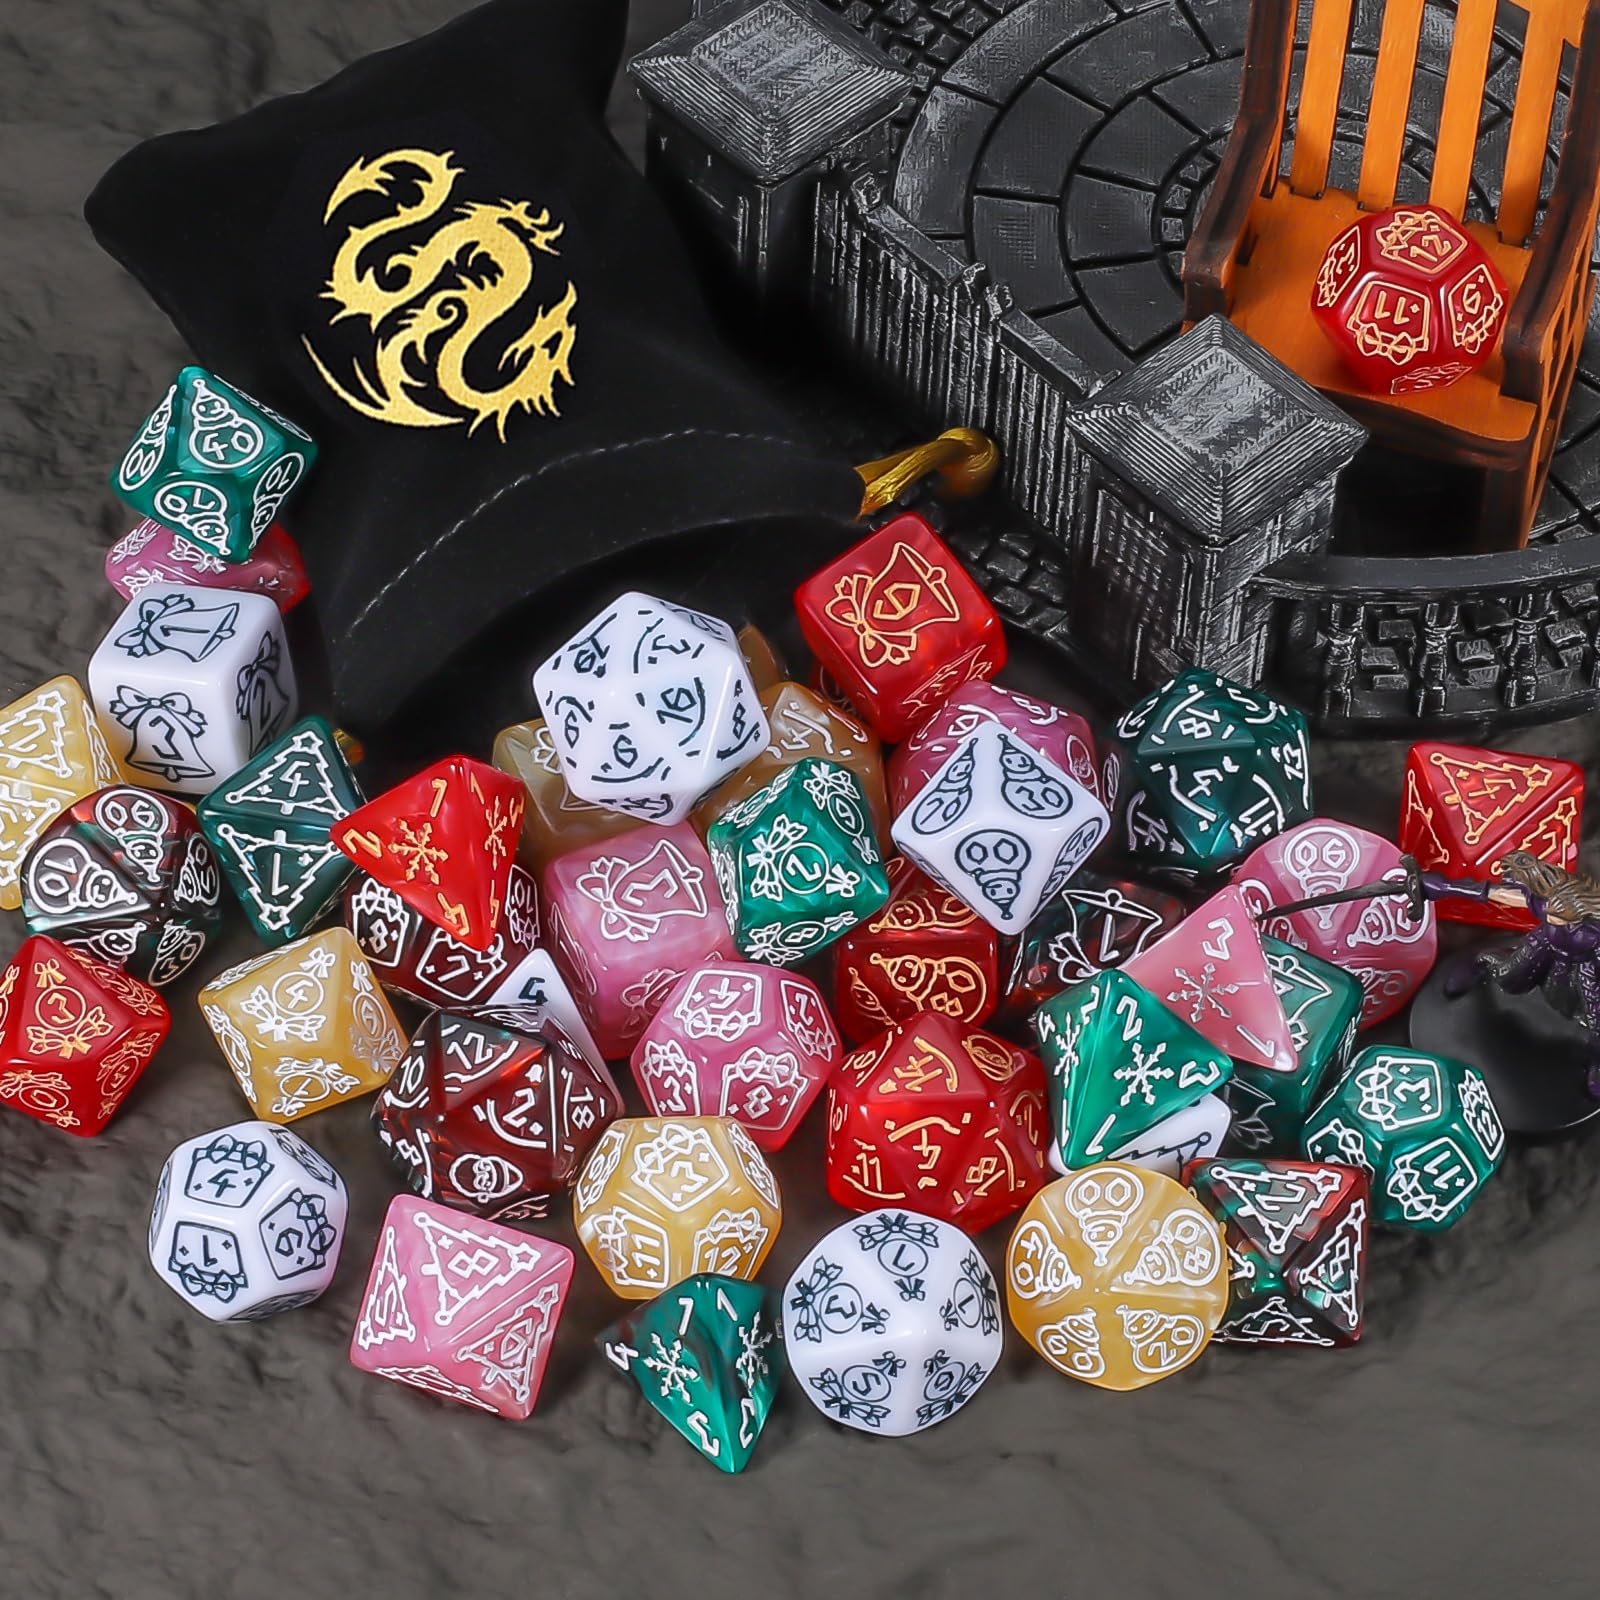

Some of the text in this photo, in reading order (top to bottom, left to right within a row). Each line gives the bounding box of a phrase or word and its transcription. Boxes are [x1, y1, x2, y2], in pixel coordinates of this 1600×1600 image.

[1410, 234, 1452, 262] 12
[1374, 290, 1410, 325] 11
[203, 430, 255, 461] 40
[126, 449, 157, 480] 00
[651, 634, 692, 654] 3
[8, 718, 48, 753] 2
[148, 715, 185, 762] 3
[732, 702, 746, 740] 8
[1178, 706, 1221, 739] 18
[1284, 742, 1304, 780] 13
[280, 760, 311, 798] 4
[470, 772, 485, 805] 1
[1187, 768, 1224, 797] 4
[1468, 778, 1517, 800] 4
[431, 778, 448, 818] 1
[920, 797, 962, 826] 70
[1015, 786, 1062, 812] 30
[1238, 797, 1276, 836] 11
[342, 828, 383, 859] 2
[965, 837, 1020, 865] 00
[272, 852, 290, 896] 1
[785, 853, 824, 882] 2
[620, 868, 679, 907] 3
[368, 918, 389, 954] 8
[784, 927, 820, 943] 8
[1099, 913, 1120, 962] 1
[1202, 917, 1235, 961] 3
[437, 955, 471, 982] 7
[48, 992, 76, 1024] 3
[286, 979, 314, 1009] 4
[708, 977, 741, 1009] 4
[930, 969, 977, 1017] 80
[1037, 1011, 1056, 1043] 4
[1115, 995, 1143, 1042] 2
[447, 1032, 493, 1070] 12
[1235, 1024, 1275, 1058] 1
[397, 1055, 425, 1095] 10
[893, 1055, 944, 1092] 14
[1178, 1060, 1221, 1089] 3
[1393, 1077, 1431, 1103] 3
[502, 1087, 536, 1128] 2
[570, 1086, 596, 1130] 18
[663, 1075, 688, 1113] 3
[743, 1085, 774, 1120] 8
[1085, 1113, 1117, 1156] 1
[1477, 1109, 1498, 1147] 12
[912, 1127, 942, 1170] 4
[208, 1168, 239, 1198] 4
[670, 1160, 710, 1193] 3
[856, 1152, 883, 1192] 11
[965, 1157, 1006, 1196] 18
[1423, 1150, 1462, 1190] 11
[1077, 1176, 1132, 1207] 00
[1255, 1183, 1307, 1211] 2
[201, 1234, 218, 1267] 1
[447, 1248, 500, 1279] 8
[631, 1233, 661, 1268] 11
[704, 1246, 741, 1275] 12
[1014, 1231, 1044, 1286] 40
[1173, 1219, 1212, 1275] 80
[1331, 1236, 1350, 1283] 8
[678, 1296, 694, 1336] 1
[717, 1287, 738, 1322] 1
[605, 1342, 640, 1371] 4
[1148, 1326, 1196, 1368] 20
[852, 1371, 881, 1397] 5
